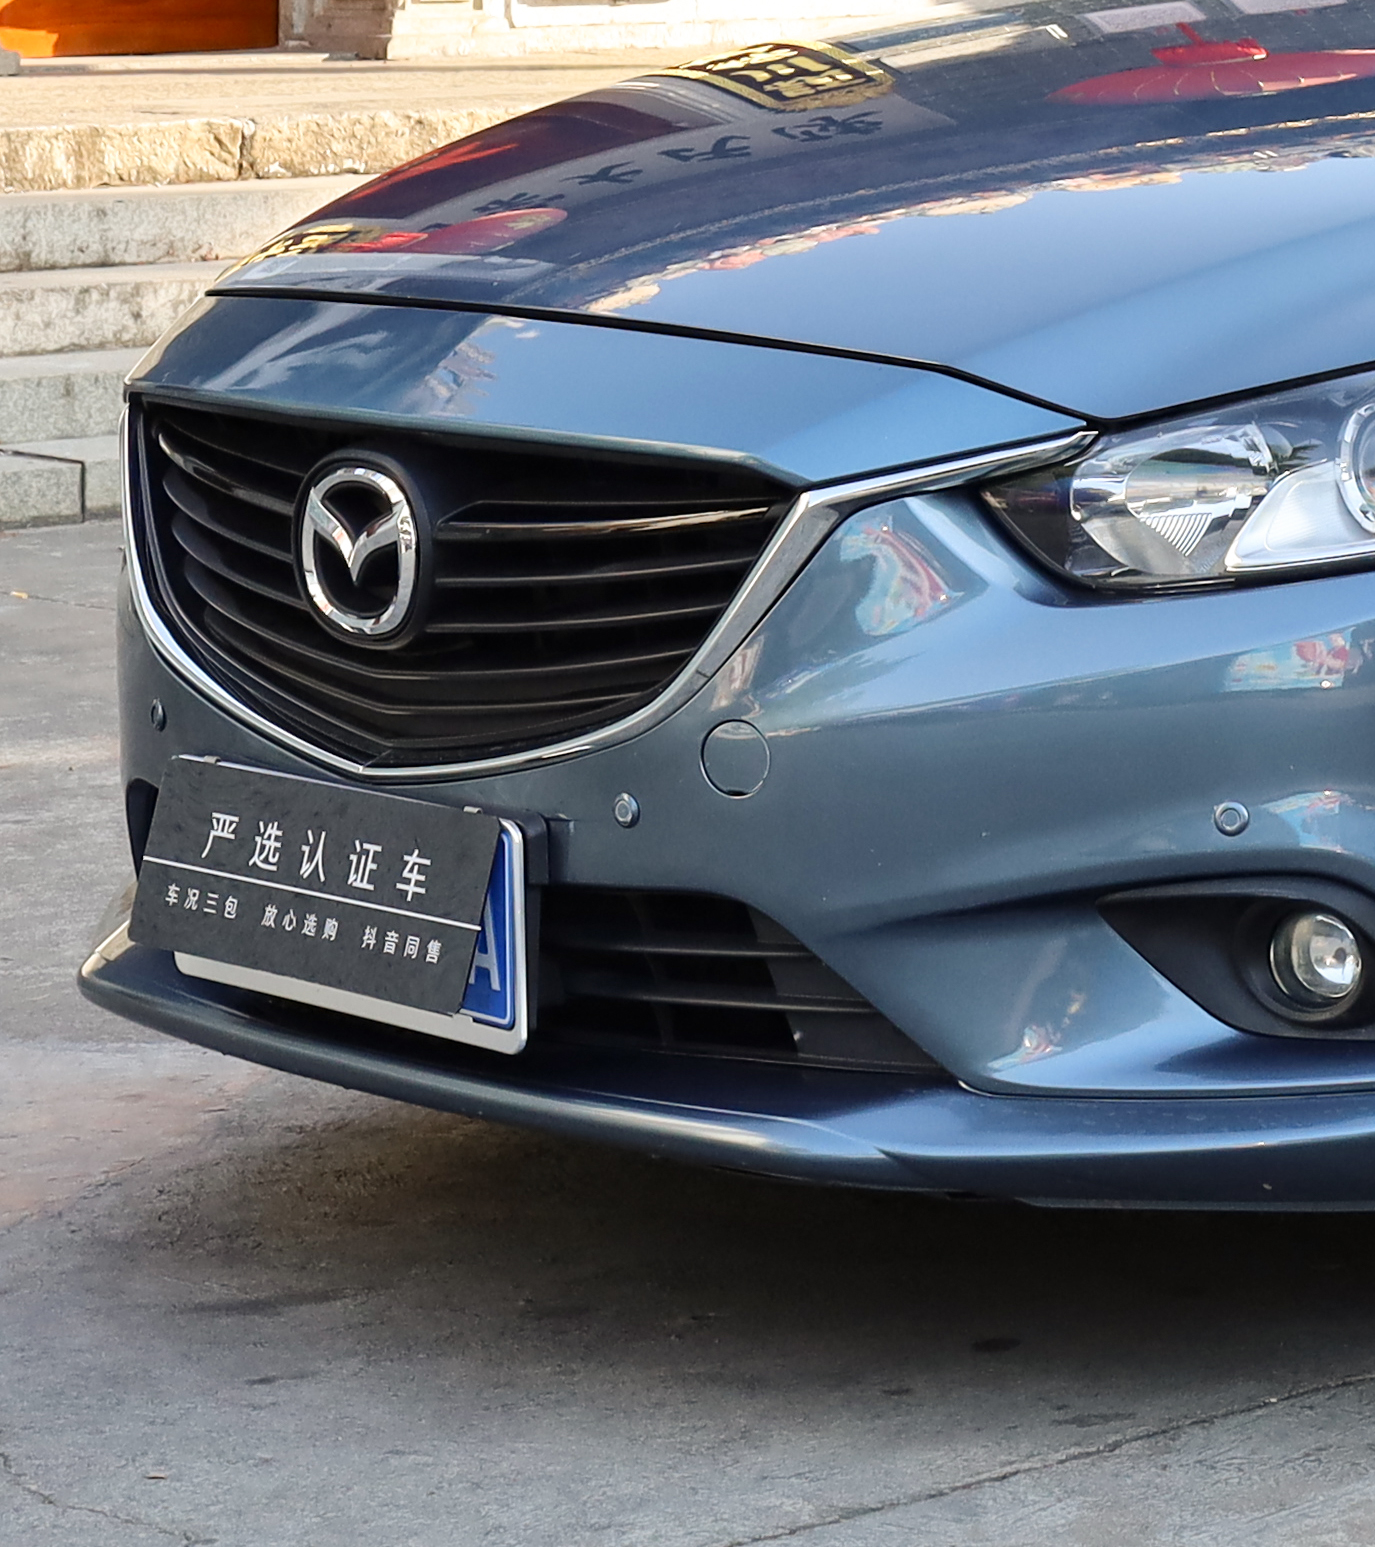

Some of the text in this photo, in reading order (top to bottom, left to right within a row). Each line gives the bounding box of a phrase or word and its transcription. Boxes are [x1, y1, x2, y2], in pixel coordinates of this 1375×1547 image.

[201, 811, 433, 902] 严选认证车
[164, 882, 443, 965] 车况三包 放心选购 抖音同售
